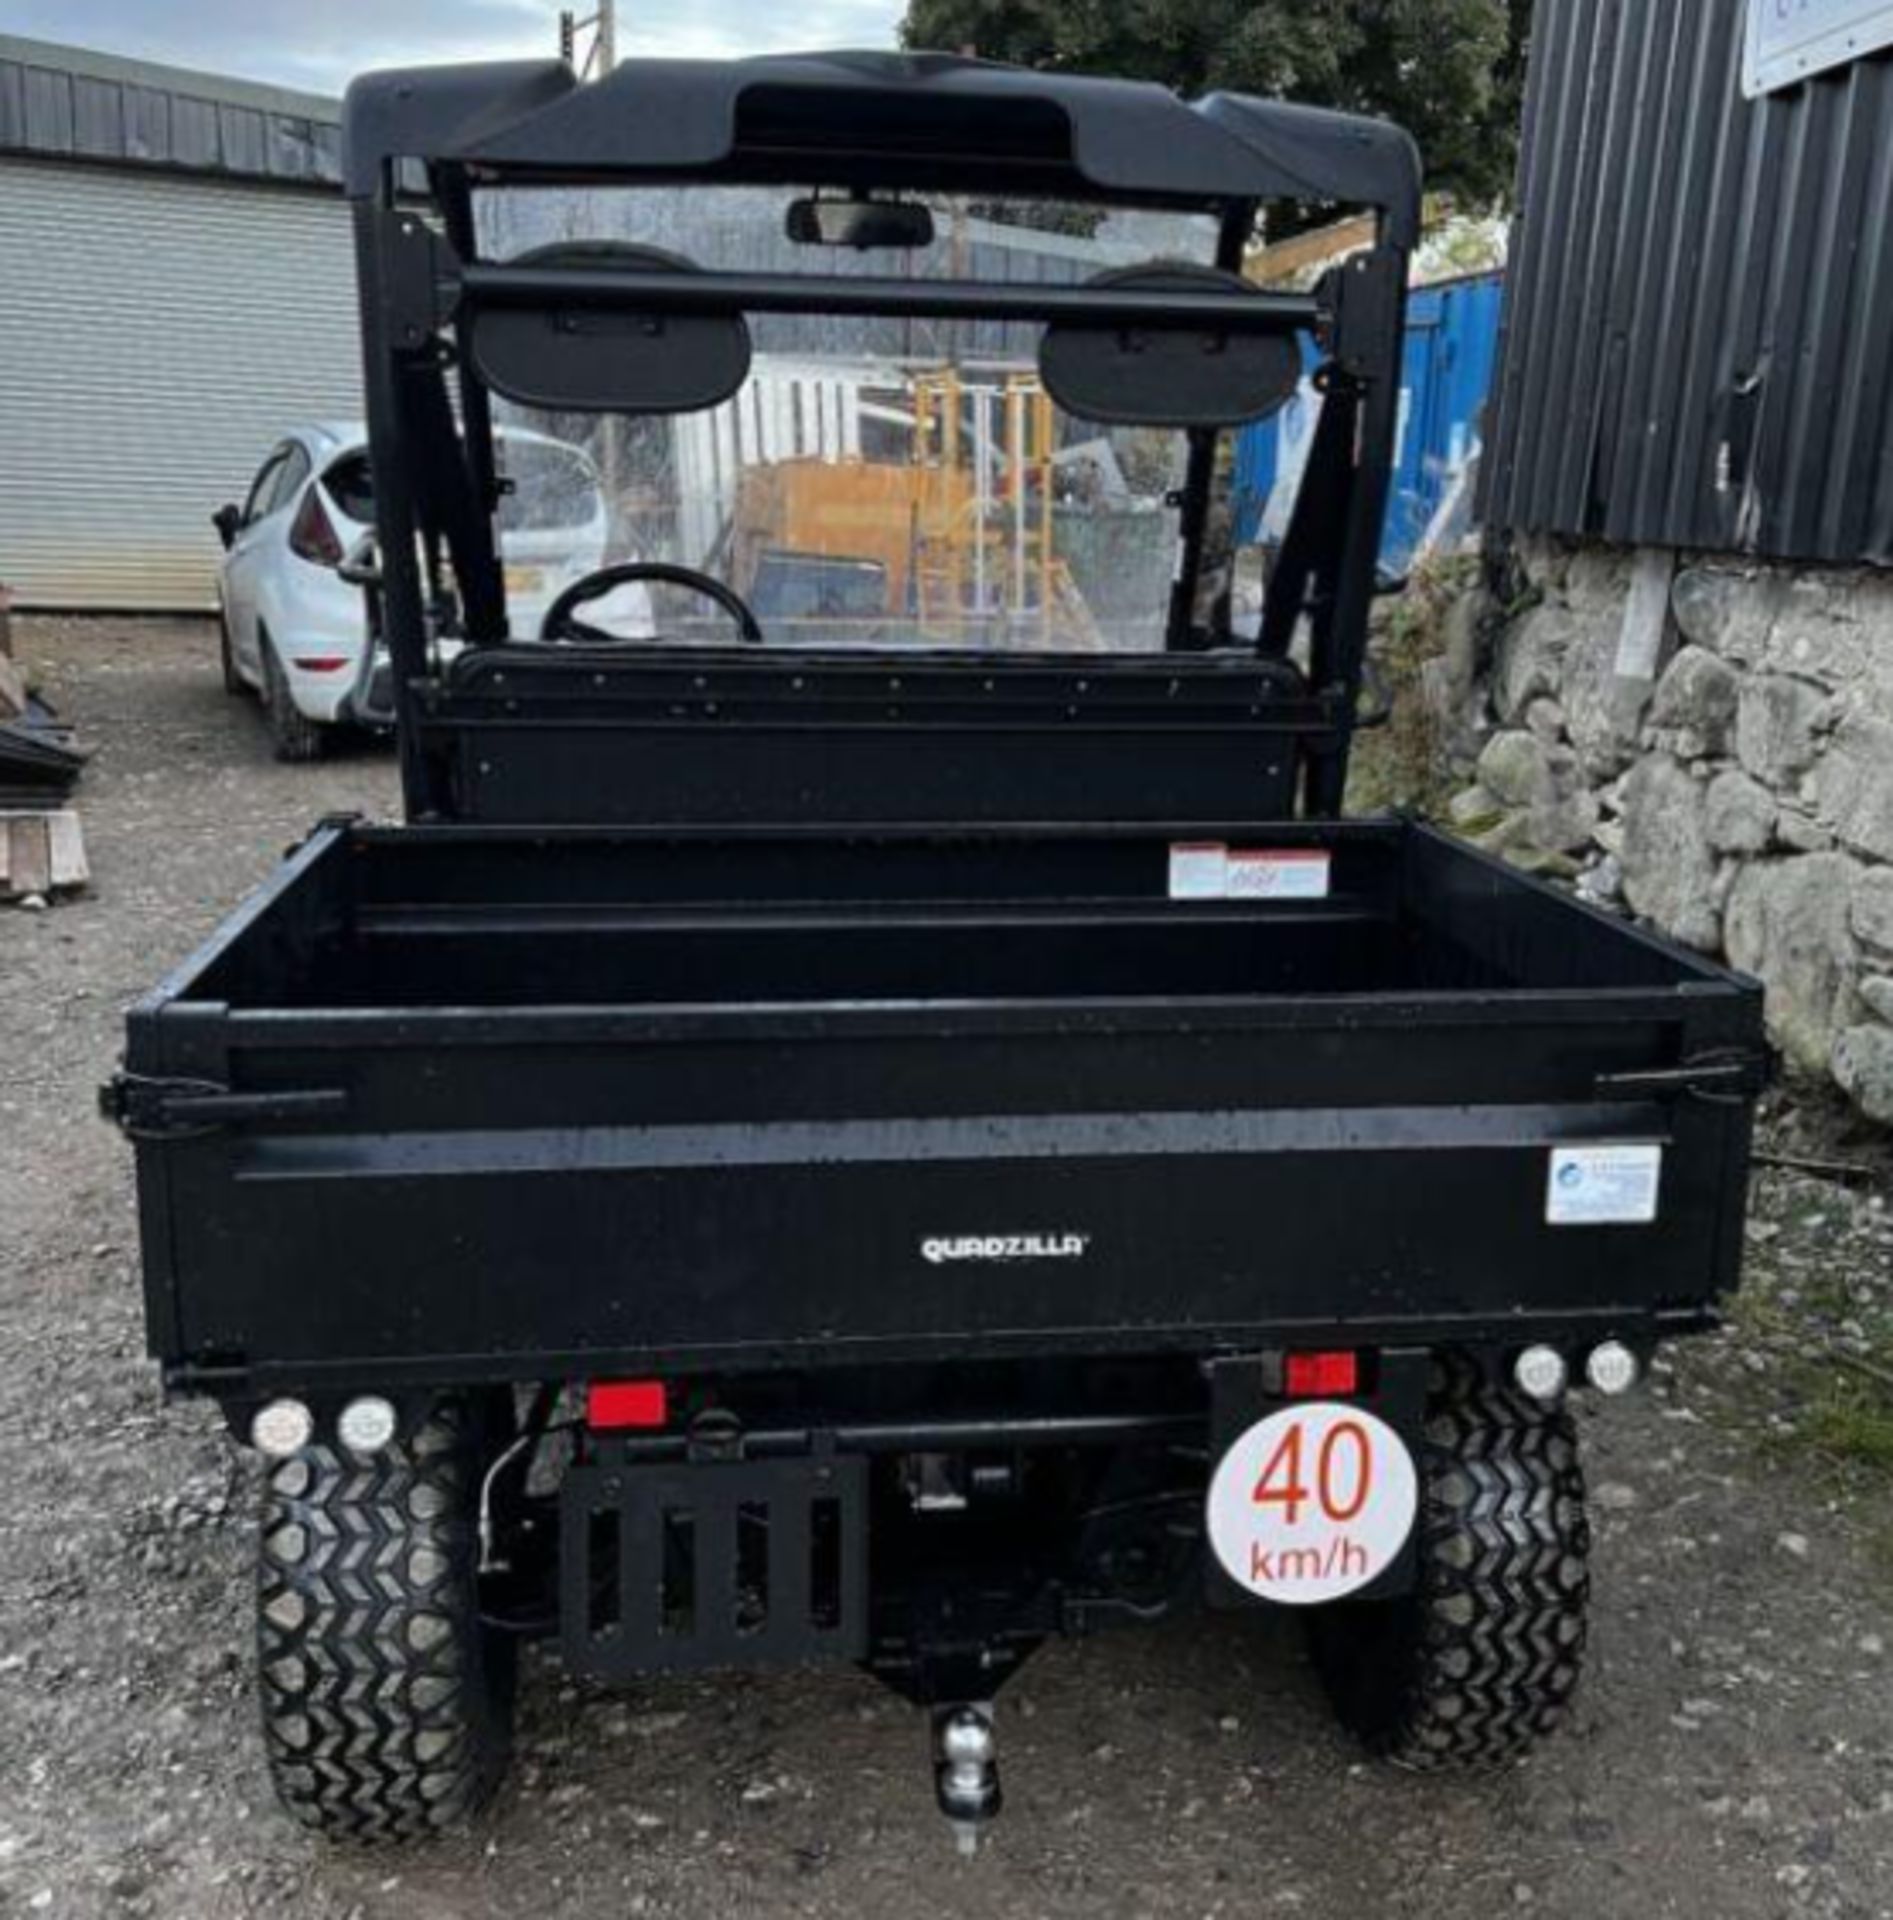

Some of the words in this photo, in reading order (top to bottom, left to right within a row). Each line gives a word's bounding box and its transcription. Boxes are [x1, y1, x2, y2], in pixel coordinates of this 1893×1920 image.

[922, 1235, 1083, 1263] QUADZILLA
[1253, 1420, 1372, 1525] 40
[1251, 1536, 1368, 1582] km/h
